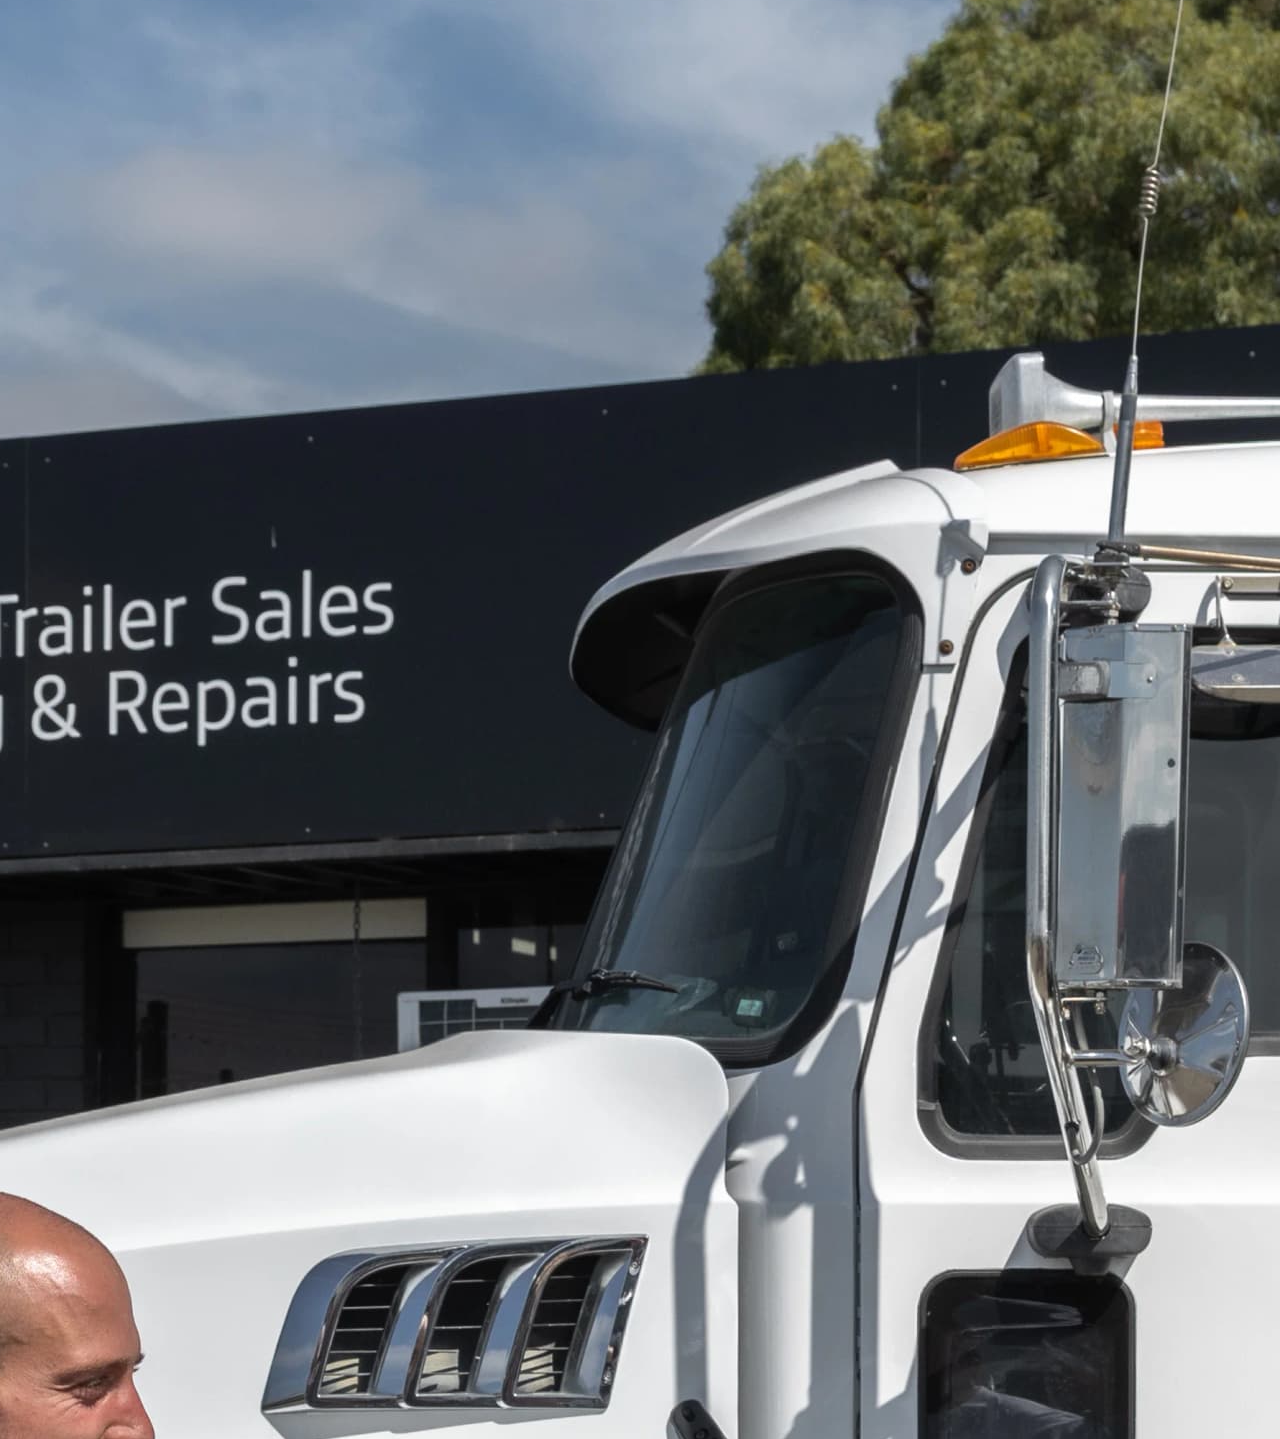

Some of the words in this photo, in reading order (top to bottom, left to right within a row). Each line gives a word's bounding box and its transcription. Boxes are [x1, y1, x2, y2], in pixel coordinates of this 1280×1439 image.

[211, 569, 395, 645] Sales
[31, 673, 81, 741] &
[108, 656, 366, 747] Repairs
